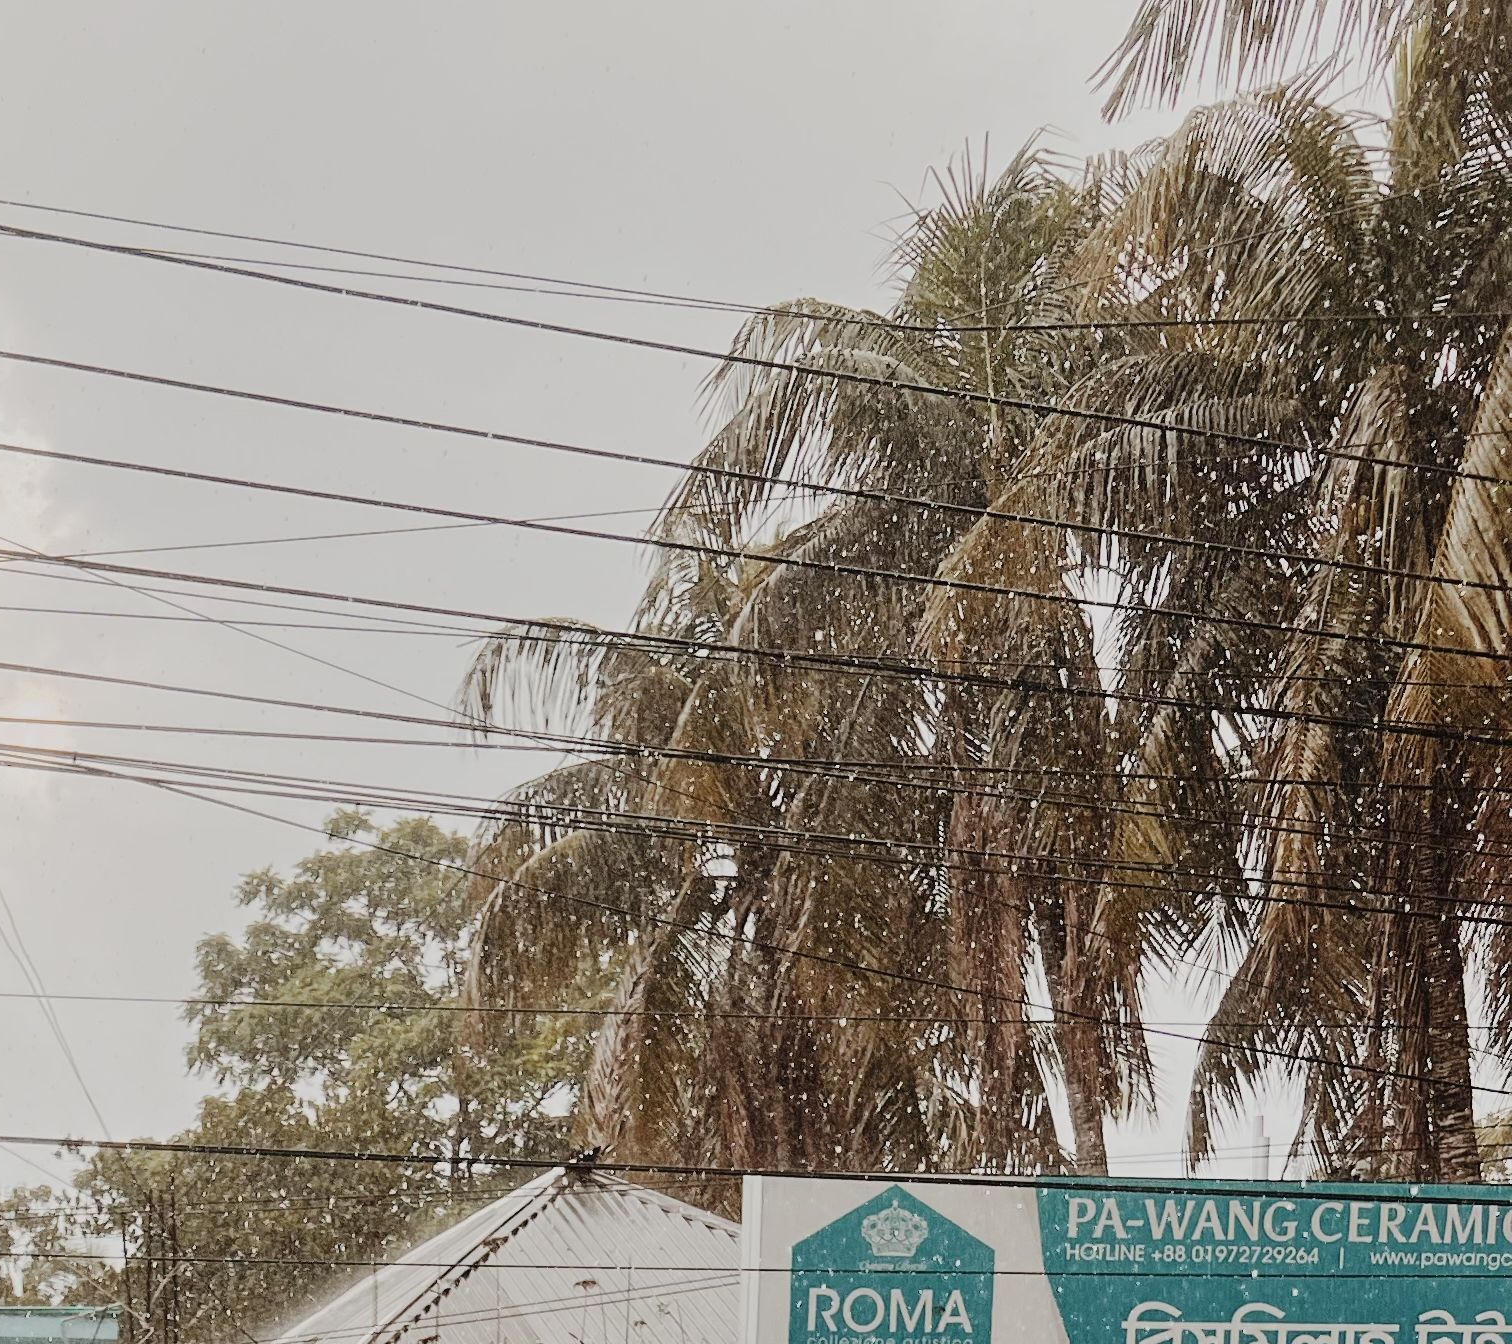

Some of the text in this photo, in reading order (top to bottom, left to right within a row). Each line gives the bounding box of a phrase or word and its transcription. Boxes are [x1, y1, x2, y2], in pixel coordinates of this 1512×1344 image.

[1067, 1198, 1298, 1242] PA-WANG
[1066, 1244, 1319, 1264] HOTLINE +88 01972729264
[807, 1287, 973, 1333] ROMA
